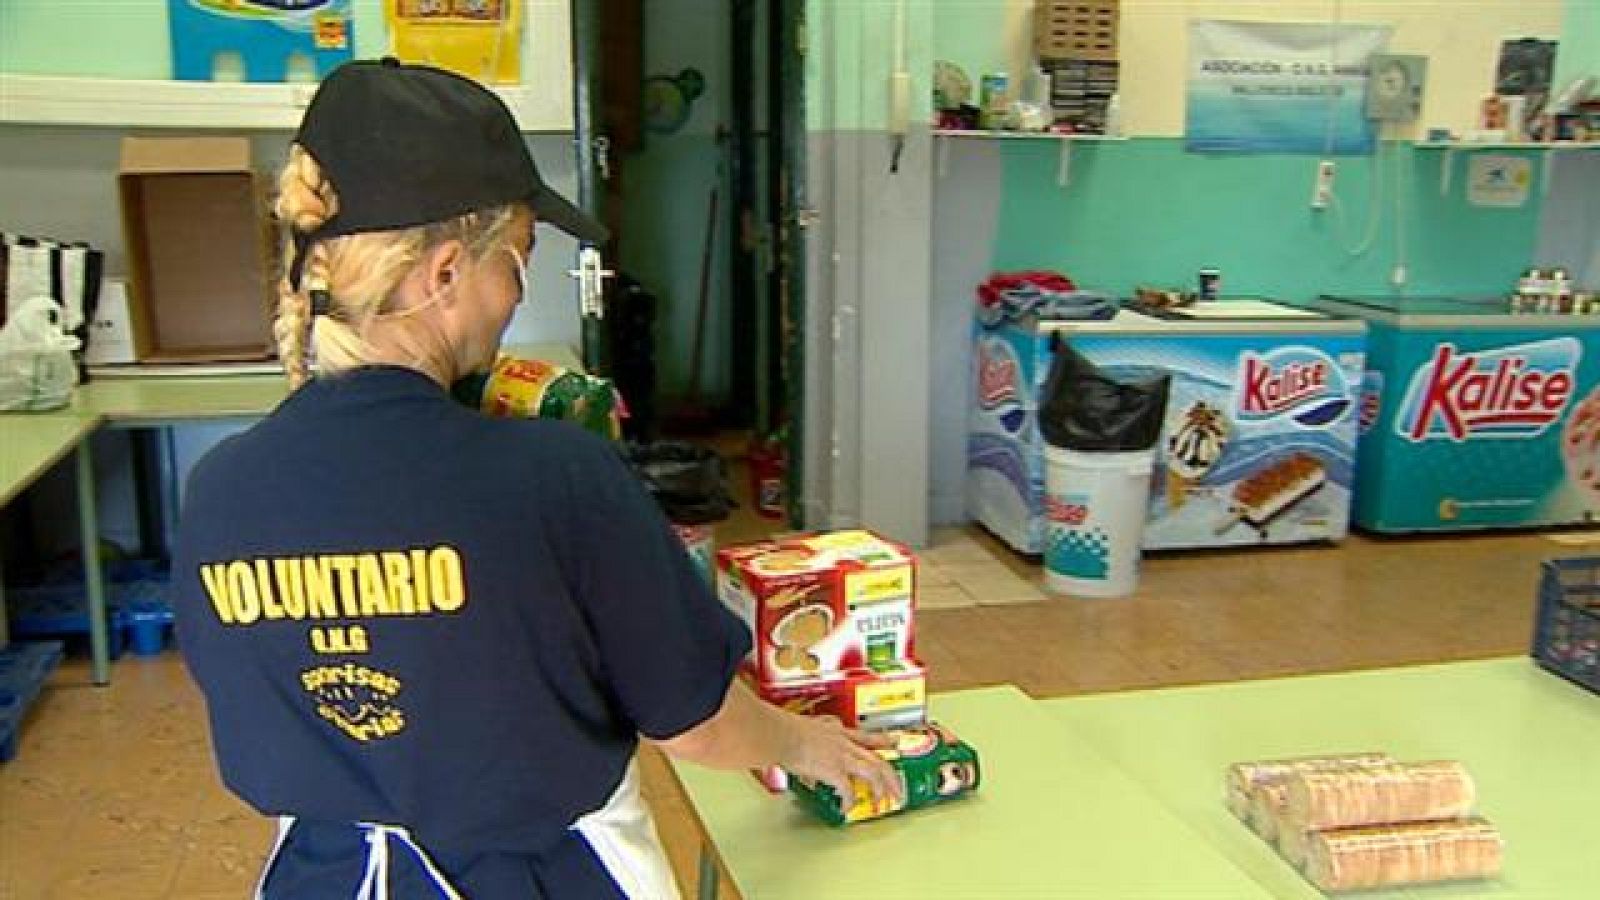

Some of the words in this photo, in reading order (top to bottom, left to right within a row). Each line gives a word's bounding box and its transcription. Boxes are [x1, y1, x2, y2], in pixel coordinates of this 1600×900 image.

[1244, 357, 1326, 411] Kalise
[1411, 346, 1571, 438] Kalise
[200, 545, 466, 625] VOLUNTARIO
